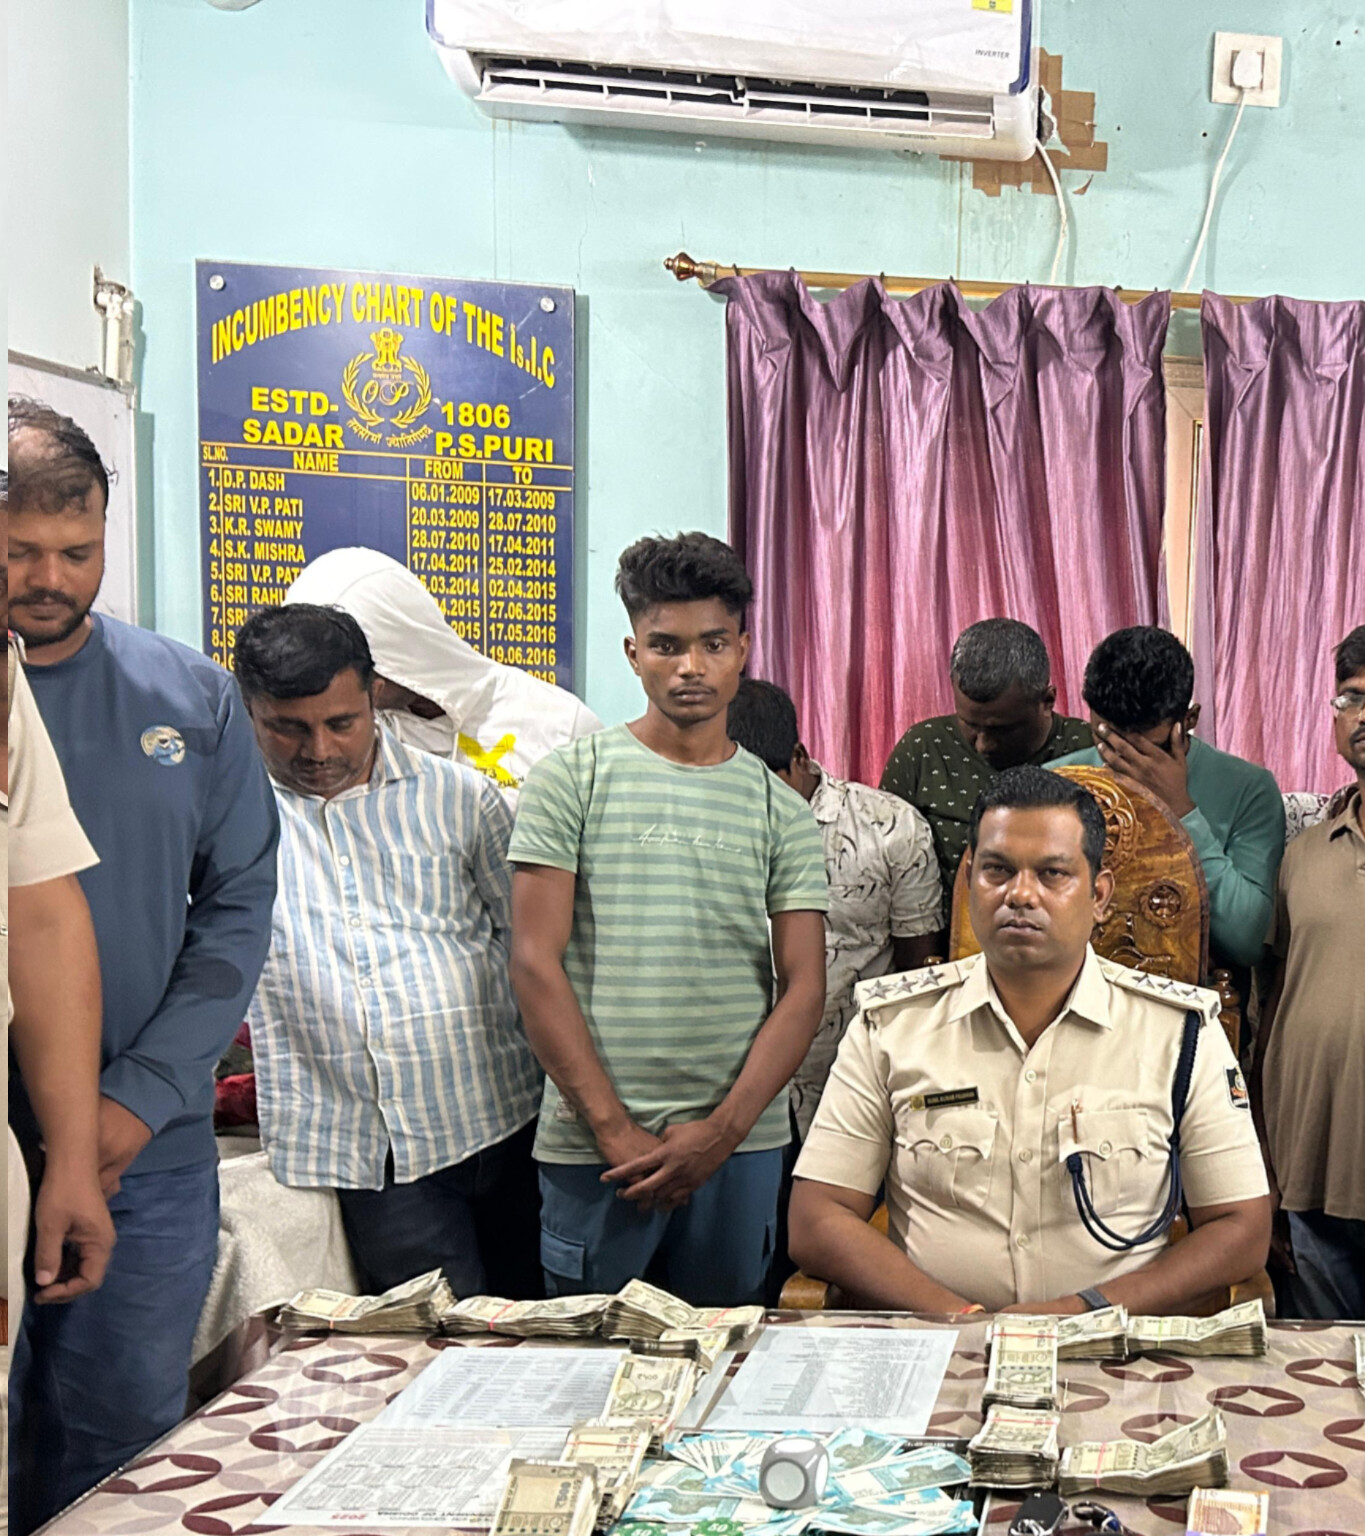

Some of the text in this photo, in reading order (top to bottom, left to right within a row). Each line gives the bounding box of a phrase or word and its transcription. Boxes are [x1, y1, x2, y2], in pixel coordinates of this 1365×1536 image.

[975, 49, 1010, 59] INVERTER
[211, 282, 345, 364] INCUMBENCY
[350, 282, 424, 328] CHART
[429, 290, 457, 338] OF
[462, 304, 503, 358] THE
[250, 386, 339, 417] ESTD-
[441, 401, 510, 429] 1806
[242, 418, 345, 450] SADAR
[203, 446, 229, 461] SL.NO.
[435, 434, 554, 463] P.S.PURI
[293, 451, 339, 472] NAME
[424, 460, 464, 480] FROM
[208, 470, 286, 492] 1. D.P. DASH
[512, 466, 533, 485] TO
[411, 482, 480, 505] 06.01.2009
[488, 487, 556, 510] 17.03.2009
[208, 492, 304, 518] 2. SRI V.P. PATI
[209, 516, 304, 540] 3. K.R. SWAMY
[411, 506, 480, 529] 20.03.2009
[488, 511, 557, 534] 28.07.2010
[209, 539, 306, 563] 4. S.K. MISHRA
[412, 529, 480, 551] 28.07.2010
[488, 534, 556, 556] 17.04.2011
[210, 561, 304, 585] 5. SRI V.P. PAT
[412, 552, 479, 573] 17.04.2011
[488, 556, 557, 578] 25.02.2014
[210, 584, 222, 602] 6.
[226, 585, 248, 604] SRI
[415, 574, 480, 596] 5.03.2014
[488, 579, 557, 600] 02.04.2015
[211, 606, 222, 625] 7.
[489, 601, 557, 622] 27.06.2015
[212, 628, 223, 648] 8.
[489, 623, 557, 644] 17.05.2016
[489, 645, 557, 666] 19.06.2016
[707, 1522, 728, 1533] 50
